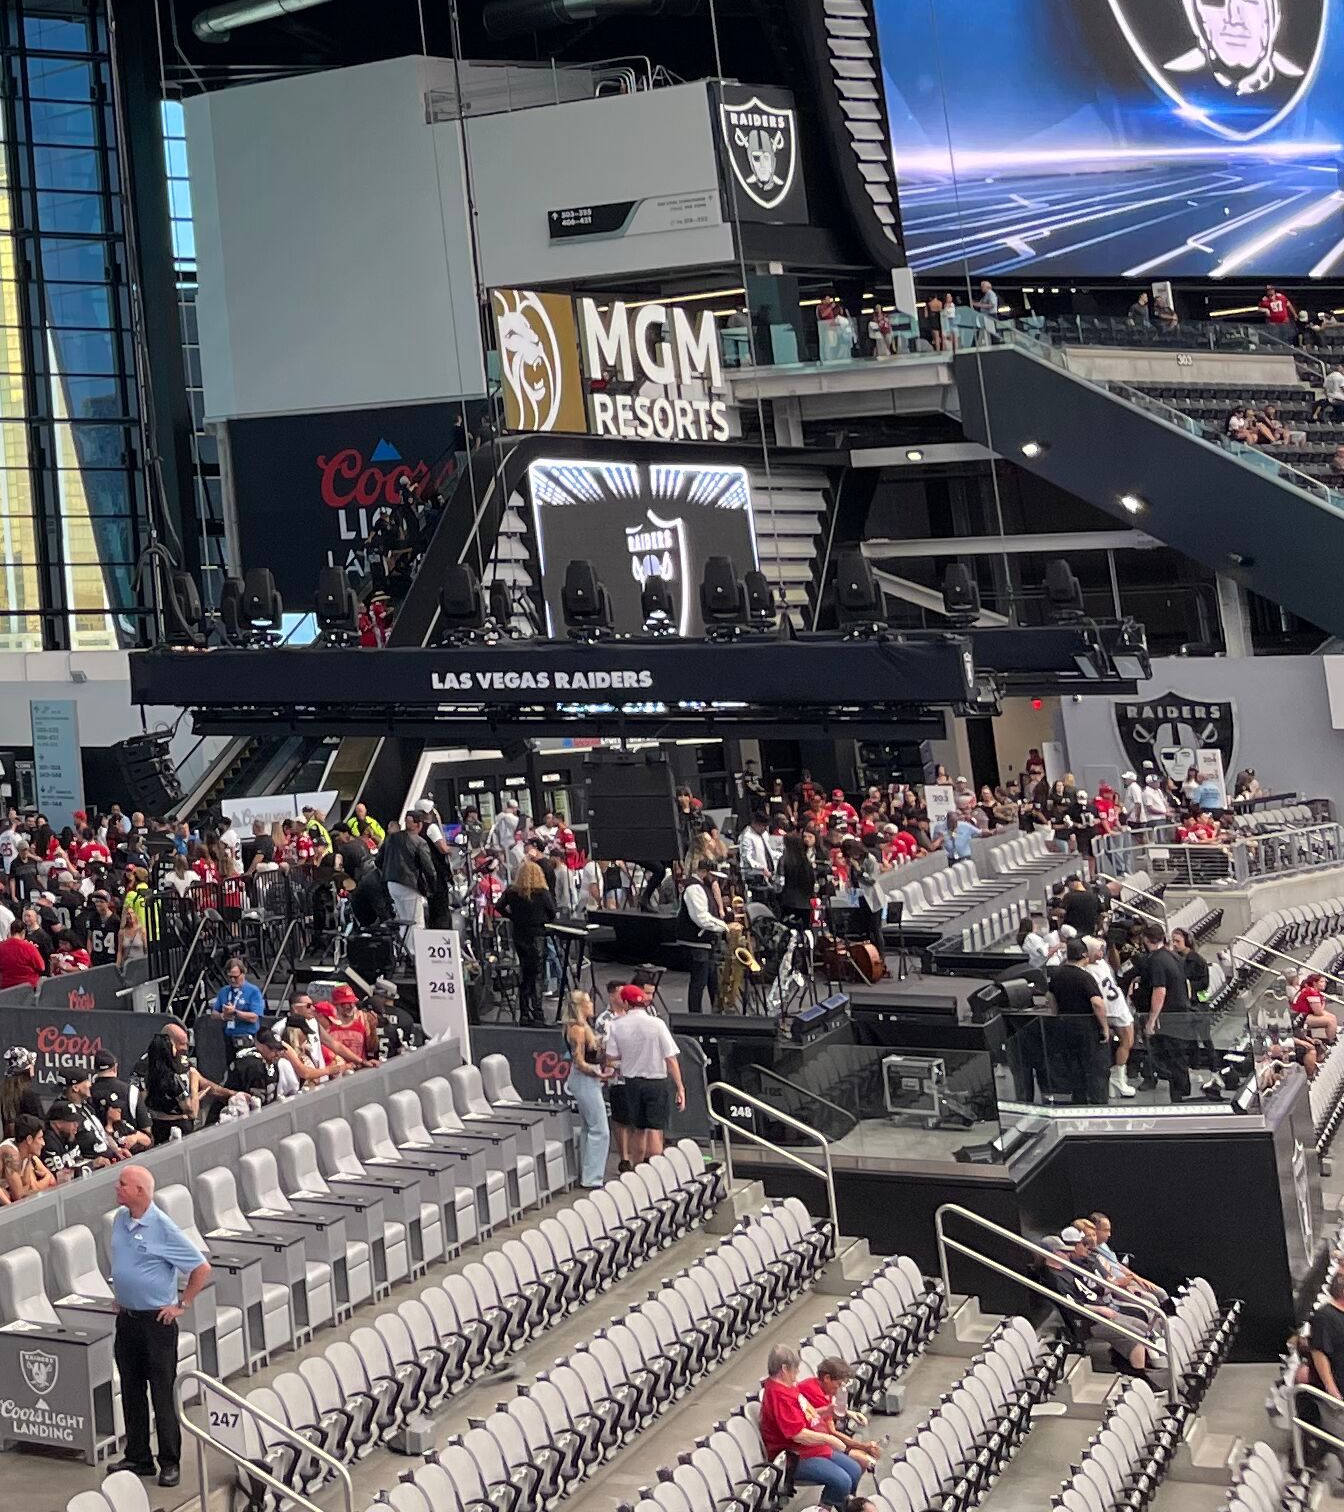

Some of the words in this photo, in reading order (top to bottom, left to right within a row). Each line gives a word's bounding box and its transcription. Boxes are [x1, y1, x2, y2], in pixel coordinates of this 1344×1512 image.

[730, 112, 785, 130] RAIDERS
[577, 298, 722, 387] MGM
[593, 393, 730, 442] RESORTS
[431, 672, 473, 690] LAS
[477, 672, 551, 689] VEGAS
[554, 670, 653, 689] RAIDERS
[1126, 705, 1221, 719] RAIDERS
[92, 931, 116, 953] 64
[427, 946, 452, 959] 201
[429, 982, 455, 994] 248
[36, 1026, 103, 1055] Coors
[729, 1105, 752, 1118] 248
[0, 1399, 43, 1423] Coors
[44, 1412, 84, 1429] LIGHT
[210, 1411, 240, 1428] 247
[13, 1421, 74, 1441] LANDING
